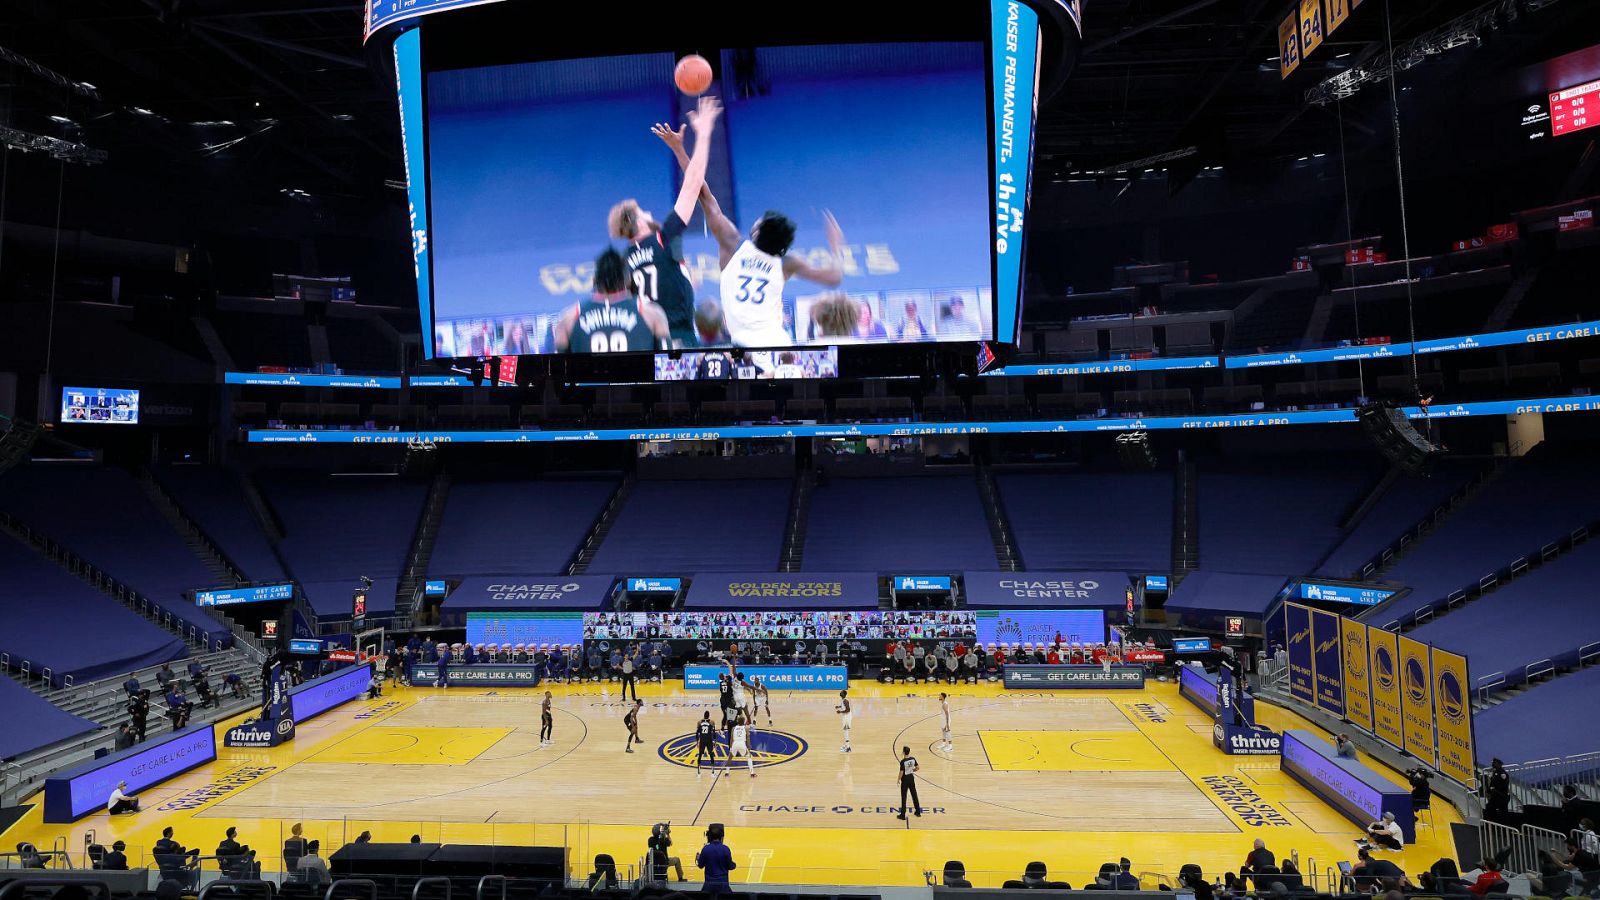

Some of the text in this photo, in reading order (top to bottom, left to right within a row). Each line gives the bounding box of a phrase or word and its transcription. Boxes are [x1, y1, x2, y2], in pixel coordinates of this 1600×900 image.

[1006, 2, 1019, 52] KAISER
[1303, 9, 1320, 50] 24
[1282, 34, 1297, 68] 42
[996, 172, 1016, 254] thrive
[735, 275, 770, 305] 33
[1526, 332, 1551, 343] GET
[1556, 328, 1590, 340] CARE
[708, 360, 722, 377] 23
[1082, 366, 1102, 374] LIKE
[1516, 406, 1541, 414] GET
[1546, 404, 1580, 412] CARE
[1000, 580, 1075, 588] CHASE
[1014, 590, 1090, 598] CENTER
[1222, 683, 1230, 708] Rakuten
[1375, 698, 1400, 714] 2014-2015
[280, 722, 290, 731] KIA
[1382, 716, 1392, 724] NBA
[1405, 712, 1431, 730] 2016-2017
[230, 728, 272, 741] thrive
[1376, 722, 1400, 737] CHAMPIONS
[1414, 732, 1424, 740] NBA
[1231, 732, 1280, 748] thrive
[1406, 735, 1433, 755] CHAMPIONS
[1440, 729, 1470, 750] 2017-2018
[130, 763, 146, 777] GET
[149, 756, 168, 770] CARE
[170, 748, 185, 762] LIKE
[194, 739, 208, 752] PRO
[1450, 751, 1460, 761] NBA
[1441, 755, 1471, 776] CHAMPIONS
[174, 766, 277, 810] WARRIORS
[1329, 776, 1342, 788] CARE
[1344, 786, 1357, 799] LIKE
[1364, 798, 1378, 816] PRO
[740, 805, 826, 813] CHASE
[1200, 776, 1272, 826] WARRIORS
[1222, 776, 1292, 826] GOLDEN STATE
